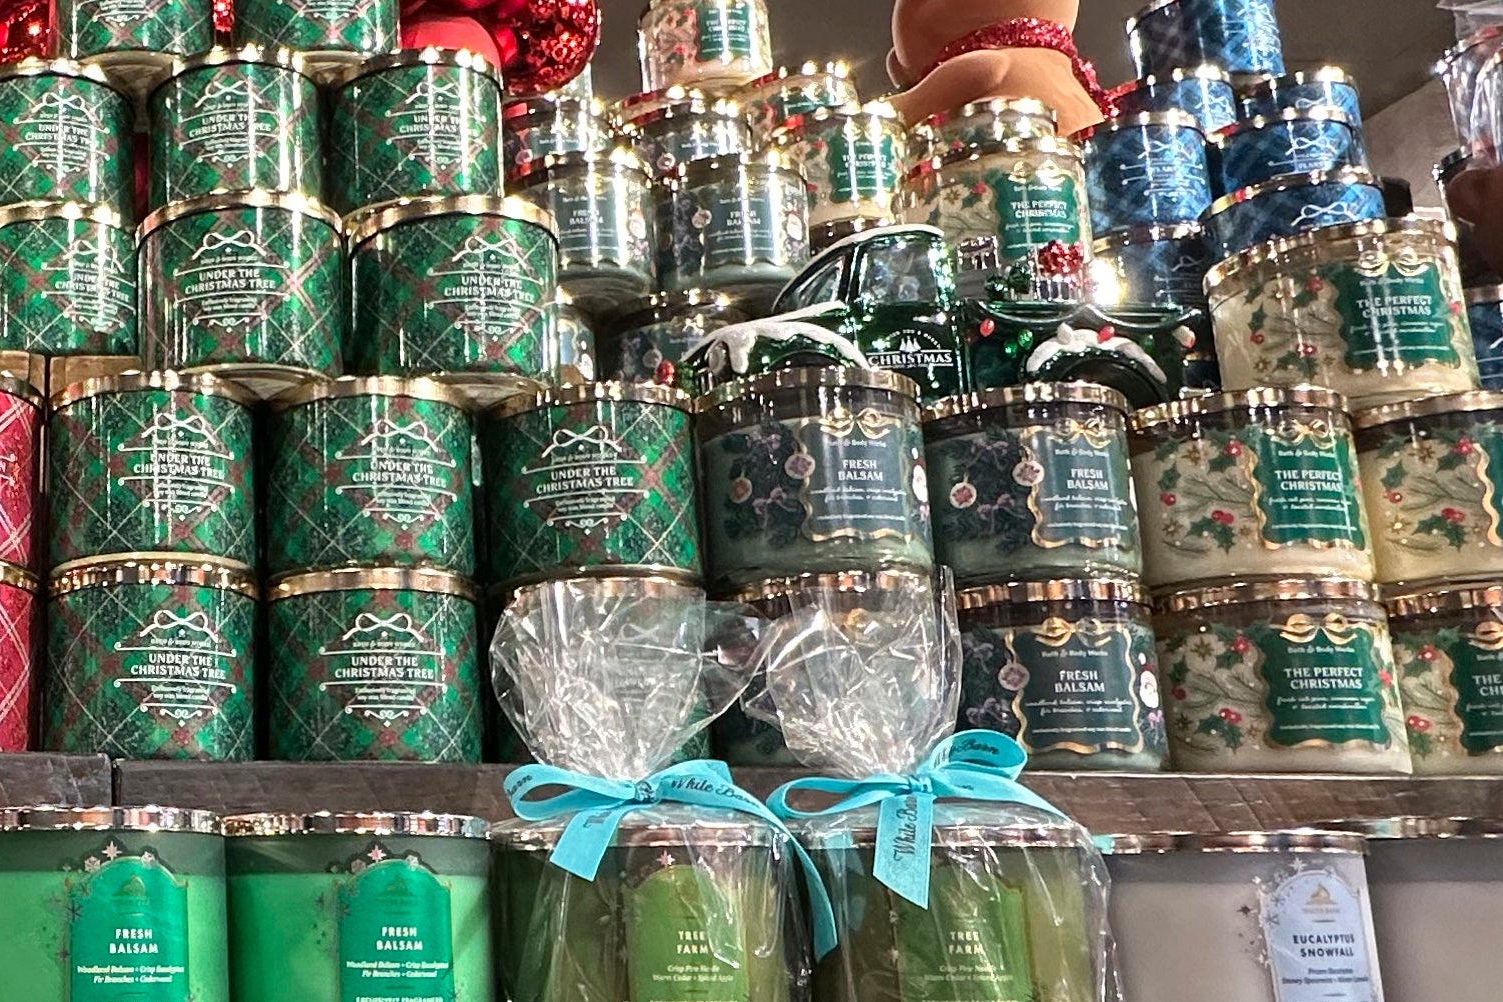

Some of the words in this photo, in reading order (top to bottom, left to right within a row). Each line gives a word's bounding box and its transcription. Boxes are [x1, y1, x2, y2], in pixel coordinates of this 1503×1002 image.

[201, 114, 235, 126] UNDER
[189, 122, 245, 138] CHRISTMAS
[199, 268, 237, 280] UNDER
[239, 268, 260, 278] THE
[185, 279, 246, 294] CHRISTMAS
[249, 279, 276, 290] TREE
[444, 287, 511, 297] CHRISTMAS
[1356, 299, 1382, 307] THE
[1385, 296, 1432, 306] PERFECT
[1362, 306, 1431, 318] CHRISTMAS
[868, 354, 952, 367] CHRISTMAS
[192, 455, 211, 466] THE
[843, 459, 877, 471] FRESH
[199, 468, 224, 480] TREE
[550, 468, 591, 481] UNDER
[594, 466, 616, 477] THE
[837, 470, 883, 481] BALSAM
[1070, 468, 1104, 479] FRESH
[1275, 470, 1299, 481] THE
[1301, 470, 1344, 481] PERFECT
[352, 472, 421, 485] CHRISTMAS
[423, 475, 447, 489] TREE
[536, 477, 603, 494] CHRISTMAS
[606, 476, 633, 488] TREE
[1067, 479, 1108, 491] BALSAM
[1280, 480, 1344, 493] CHRISTMAS
[148, 653, 190, 666] UNDER
[193, 654, 212, 666] THE
[351, 656, 392, 667] UNDER
[395, 656, 418, 667] THE
[130, 665, 199, 678] CHRISTMAS
[201, 668, 226, 680] TREE
[335, 667, 403, 679] CHRISTMAS
[406, 669, 434, 680] TREE
[1059, 670, 1098, 681] FRESH
[1284, 668, 1311, 678] THE
[1314, 667, 1363, 677] PERFECT
[1055, 681, 1105, 693] BALSAM
[1290, 678, 1362, 690] CHRISTMAS
[671, 778, 714, 794] White
[893, 821, 916, 861] White
[116, 929, 152, 939] FRESH
[382, 927, 417, 937] FRESH
[678, 931, 705, 941] TREE
[950, 931, 980, 941] TREE
[1293, 934, 1355, 944] EUCALYPTUS
[109, 943, 158, 954] BALSAM
[377, 941, 422, 950] BALSAM
[677, 945, 709, 954] FARM
[949, 944, 984, 954] FARM
[1300, 948, 1354, 957] SNOWFALL
